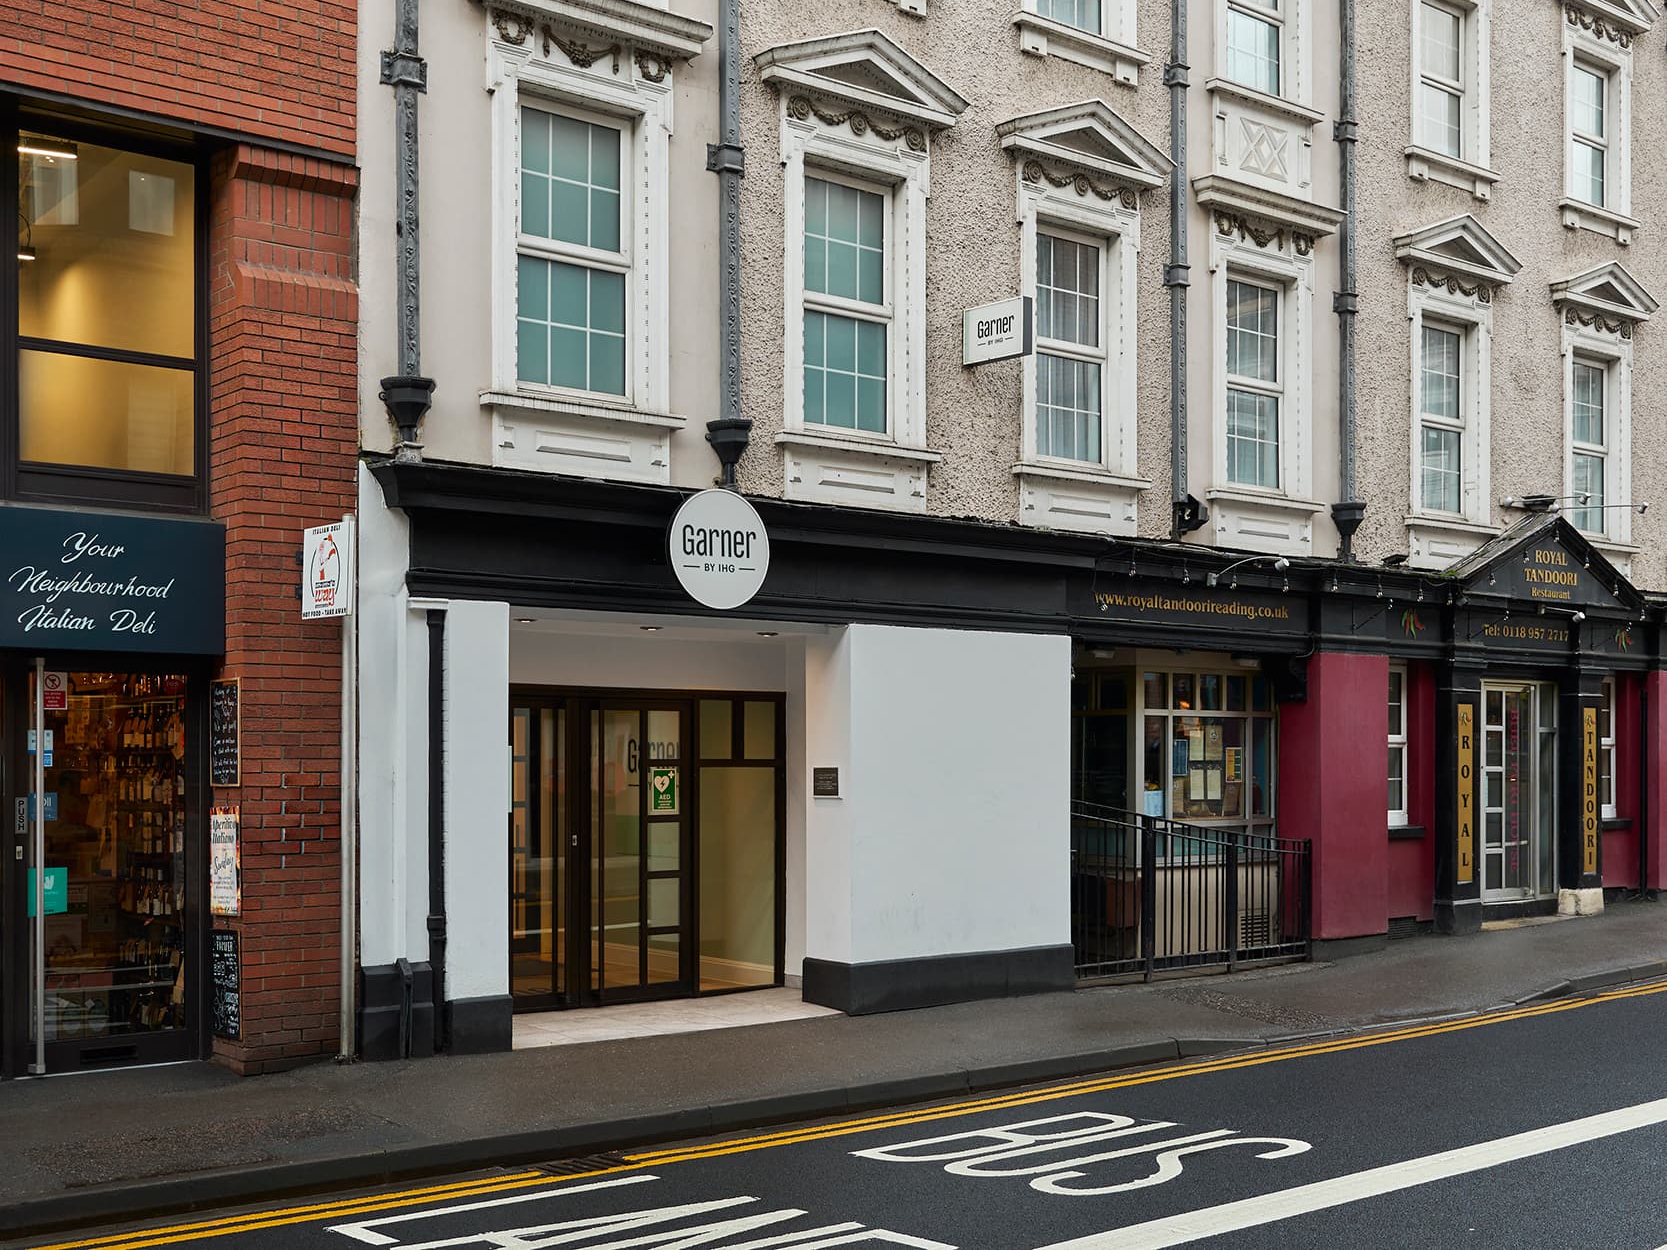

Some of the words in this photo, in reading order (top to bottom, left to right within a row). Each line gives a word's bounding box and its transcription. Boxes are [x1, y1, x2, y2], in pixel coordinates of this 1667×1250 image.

[977, 315, 1014, 339] Garner
[312, 526, 330, 535] ITALIAN
[682, 524, 757, 559] Garner
[61, 532, 125, 564] Your
[1535, 550, 1568, 566] ROYAL
[704, 563, 715, 572] BY
[718, 563, 735, 573] IHG
[1524, 568, 1578, 586] TANDOORI
[8, 565, 175, 603] Neighbourhood
[1531, 587, 1571, 600] Restaurant
[1094, 591, 1289, 619] www.royaltandoorireading.co.uk
[17, 604, 97, 632] Italian
[109, 609, 156, 635] Deli
[1502, 625, 1526, 638] 0118
[1528, 627, 1545, 640] 957
[1547, 629, 1569, 642] 2717
[1461, 735, 1470, 867] ROYAL
[1586, 731, 1595, 865] TANDOORI
[848, 1111, 1313, 1196] BUS
